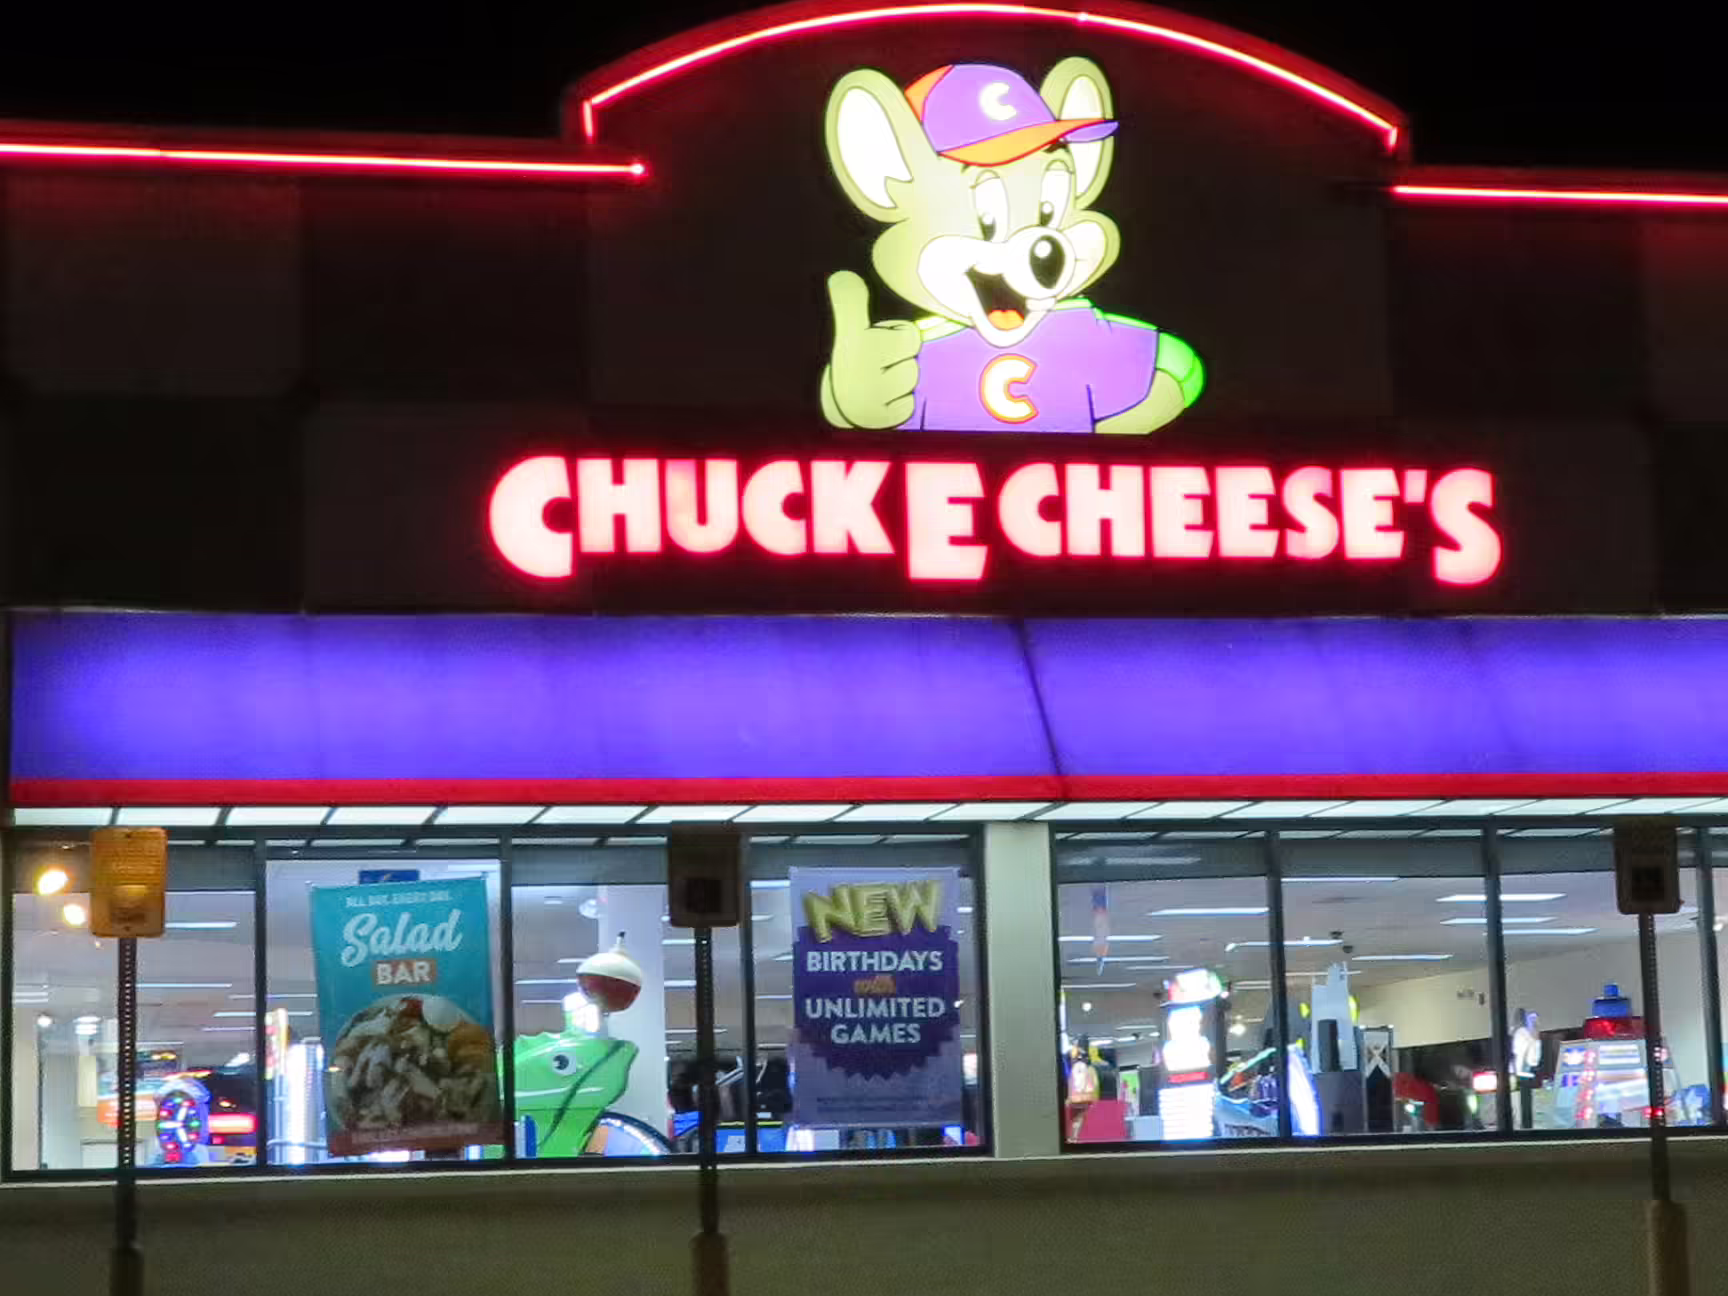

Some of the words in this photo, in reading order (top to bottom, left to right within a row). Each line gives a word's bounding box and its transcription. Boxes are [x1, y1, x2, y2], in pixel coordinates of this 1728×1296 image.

[977, 354, 1040, 423] C
[489, 456, 894, 578] CHUCK
[905, 462, 987, 580] E
[998, 463, 1500, 584] CHEESE'S
[804, 880, 943, 943] NEW
[341, 908, 463, 968] Salad
[376, 962, 432, 985] BAR
[806, 951, 943, 972] BIRTHDAYS
[805, 997, 945, 1019] UNLIMITED
[831, 1023, 921, 1045] GAMES
